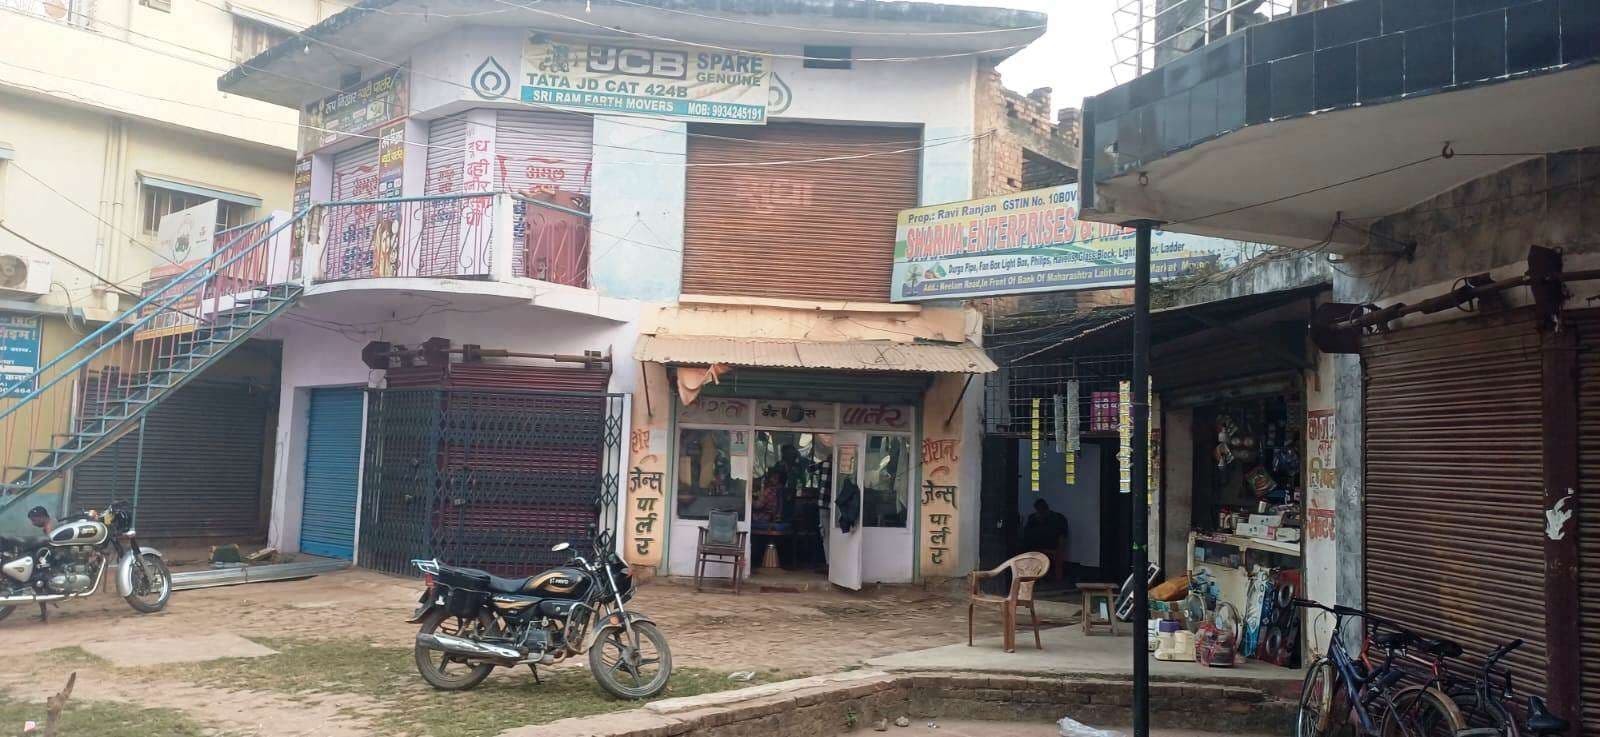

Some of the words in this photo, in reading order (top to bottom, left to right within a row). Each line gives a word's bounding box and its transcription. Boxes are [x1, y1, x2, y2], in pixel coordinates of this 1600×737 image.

[588, 47, 686, 79] JCB
[696, 52, 763, 73] SPARE
[526, 73, 570, 88] TATA
[576, 78, 599, 90] JD
[605, 80, 639, 94] CAT
[645, 84, 687, 98] 424B
[696, 72, 761, 86] GENUINE
[533, 90, 553, 102] SRI
[556, 92, 581, 104] RAM
[585, 94, 623, 107] EARTH
[626, 97, 674, 112] MOVERS
[688, 102, 710, 116] MOB:
[712, 104, 762, 120] 9934245191
[467, 158, 490, 177] दही
[908, 213, 935, 224] Prop.:
[938, 209, 958, 219] Ravi
[961, 203, 997, 216] Ranjan
[1003, 197, 1029, 210] GSTIN
[1032, 196, 1045, 207] No.
[906, 223, 963, 260] SHARMA
[967, 207, 1076, 252] ENTERPRISES
[1160, 242, 1185, 253] Ladder
